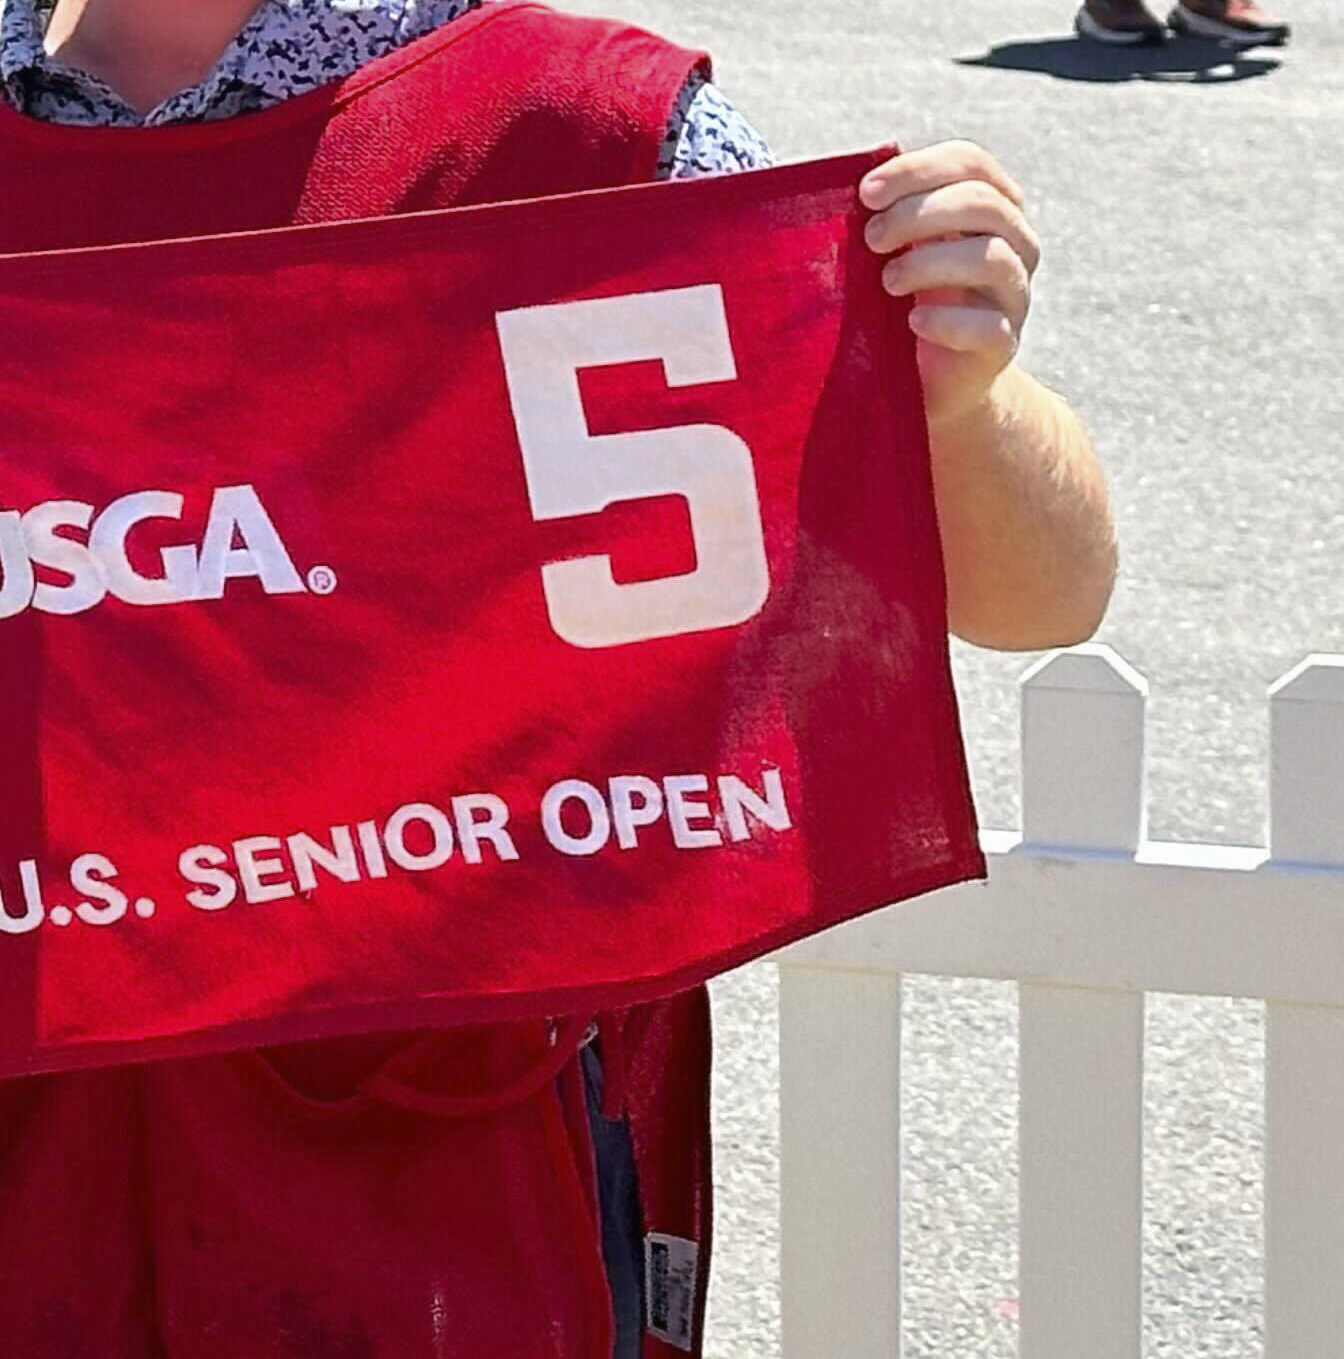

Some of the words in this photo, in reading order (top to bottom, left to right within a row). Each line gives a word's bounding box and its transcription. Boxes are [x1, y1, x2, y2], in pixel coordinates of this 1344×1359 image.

[495, 283, 771, 649] 5
[178, 793, 520, 910] SENIOR
[541, 767, 793, 856] OPEN
